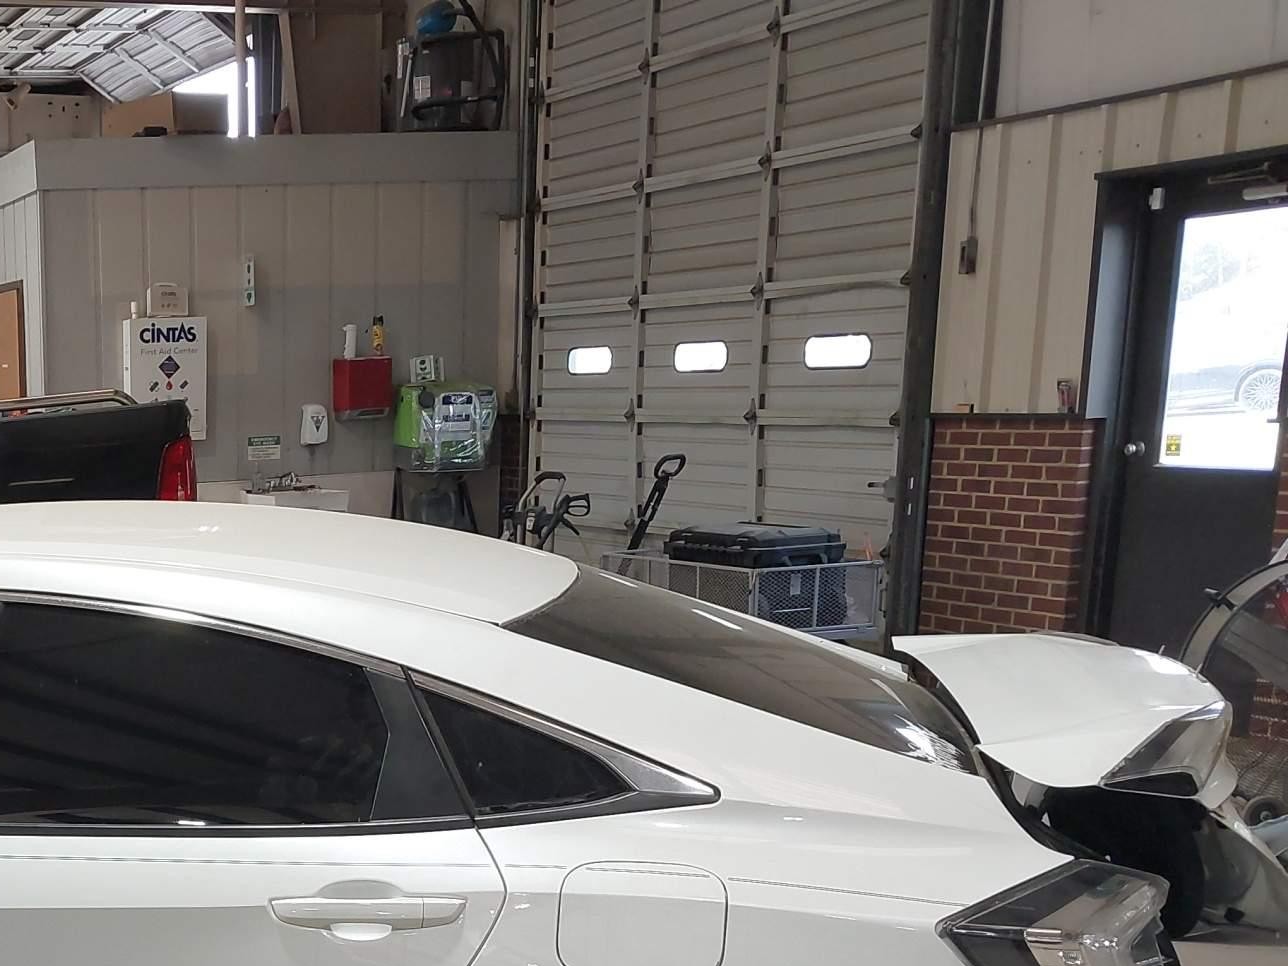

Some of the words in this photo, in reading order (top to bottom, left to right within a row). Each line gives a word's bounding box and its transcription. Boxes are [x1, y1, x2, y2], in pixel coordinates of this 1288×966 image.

[139, 321, 197, 344] CINTAS
[140, 347, 157, 357] First
[158, 347, 172, 355] Aid
[173, 346, 198, 355] Center
